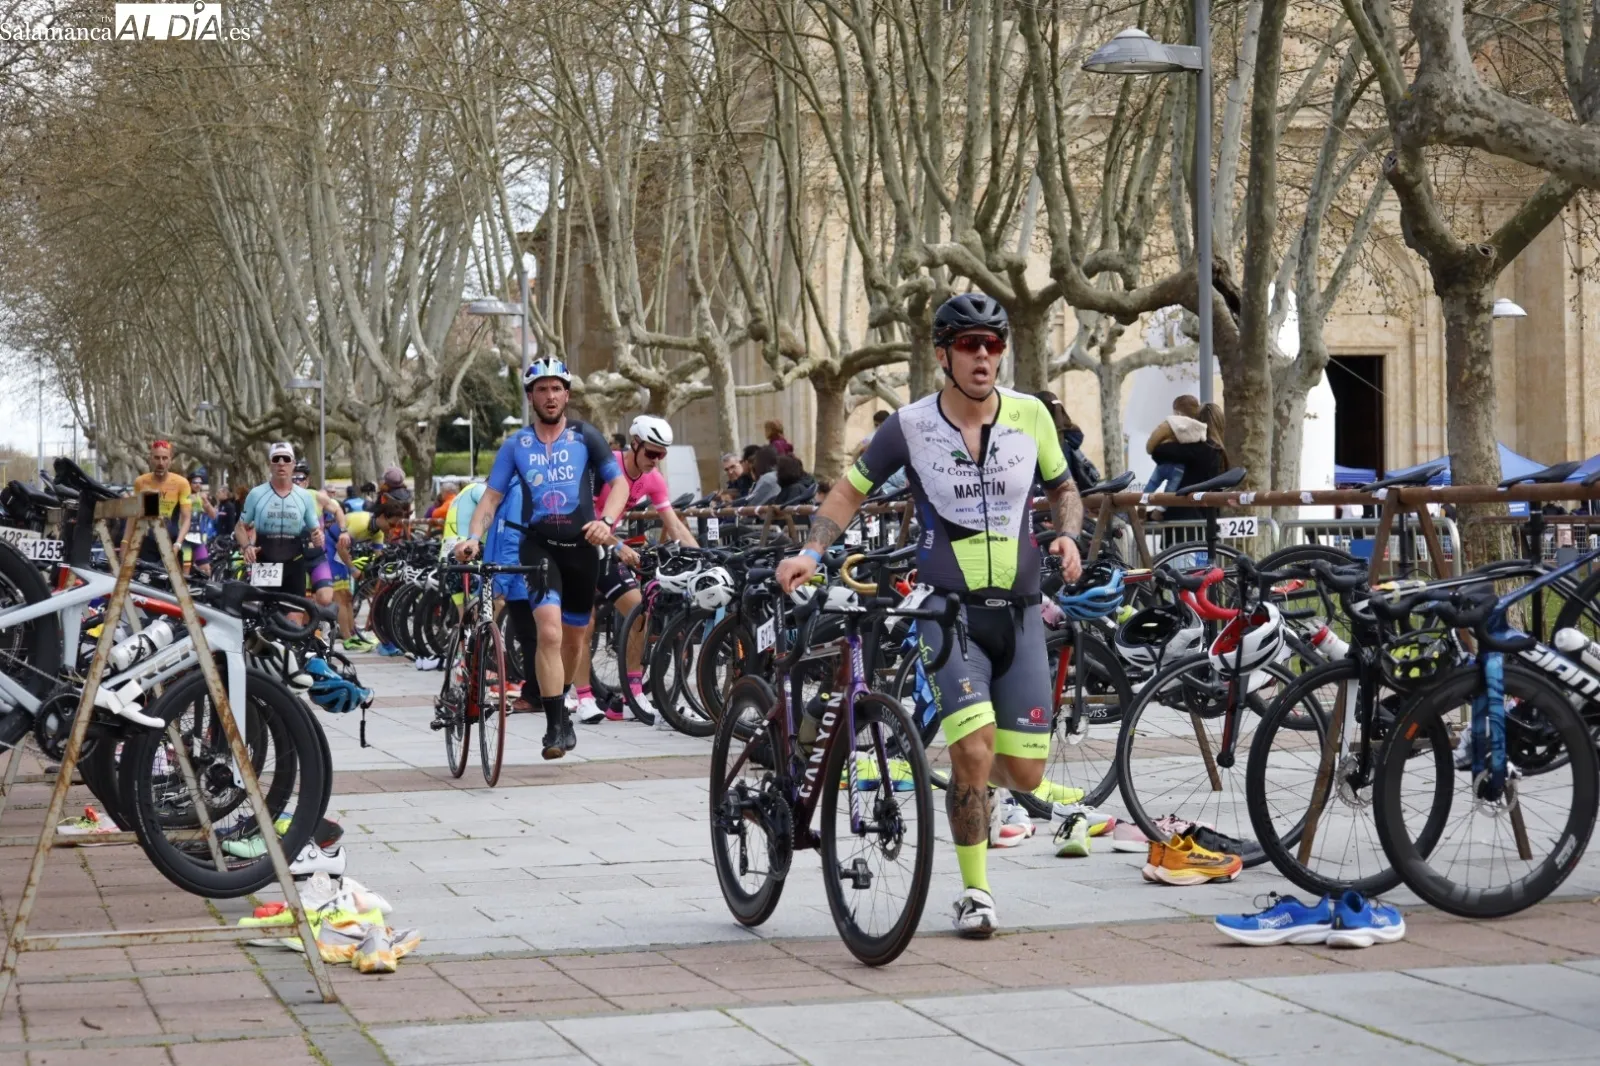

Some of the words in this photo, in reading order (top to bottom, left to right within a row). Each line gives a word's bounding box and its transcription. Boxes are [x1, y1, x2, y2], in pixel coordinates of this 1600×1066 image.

[529, 449, 569, 466] PINTO
[547, 465, 574, 482] MSC
[932, 462, 944, 473] La
[953, 477, 1006, 499] MARTÍN
[1228, 520, 1255, 536] 242
[923, 530, 935, 549] LOCA
[31, 541, 63, 560] 1255
[256, 569, 279, 579] 1242
[1518, 643, 1600, 702] GIAN
[798, 692, 844, 798] CANYON
